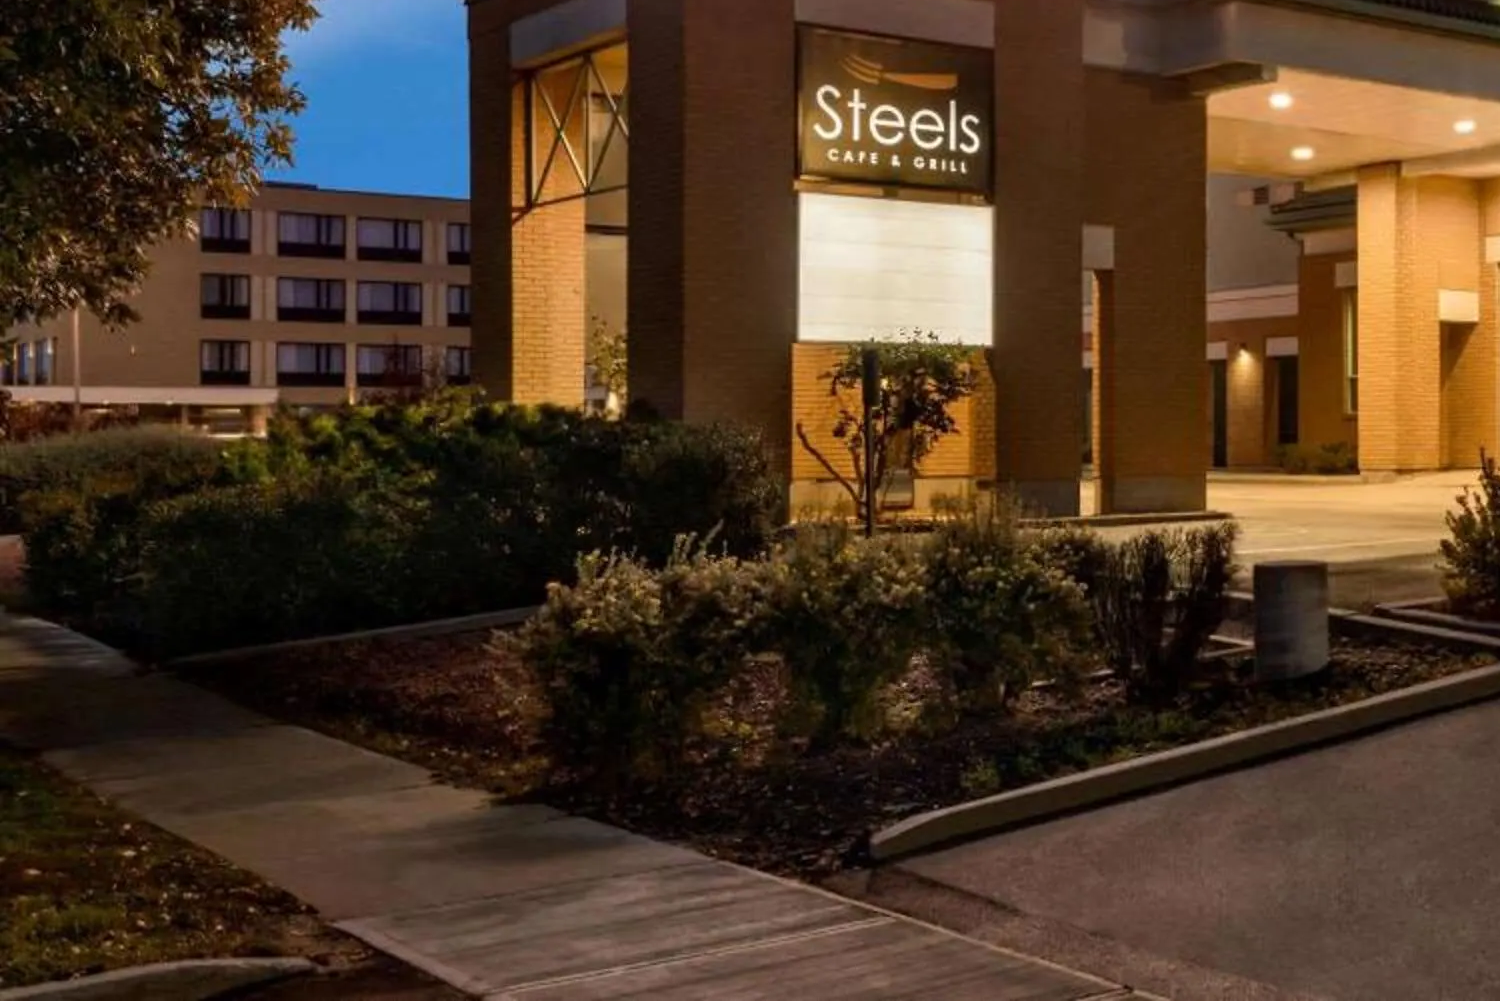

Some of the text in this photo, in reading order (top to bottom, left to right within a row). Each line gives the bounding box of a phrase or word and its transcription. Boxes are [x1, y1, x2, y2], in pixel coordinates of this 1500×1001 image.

[813, 84, 981, 155] Steels
[827, 148, 968, 174] CAFE & GRILL
